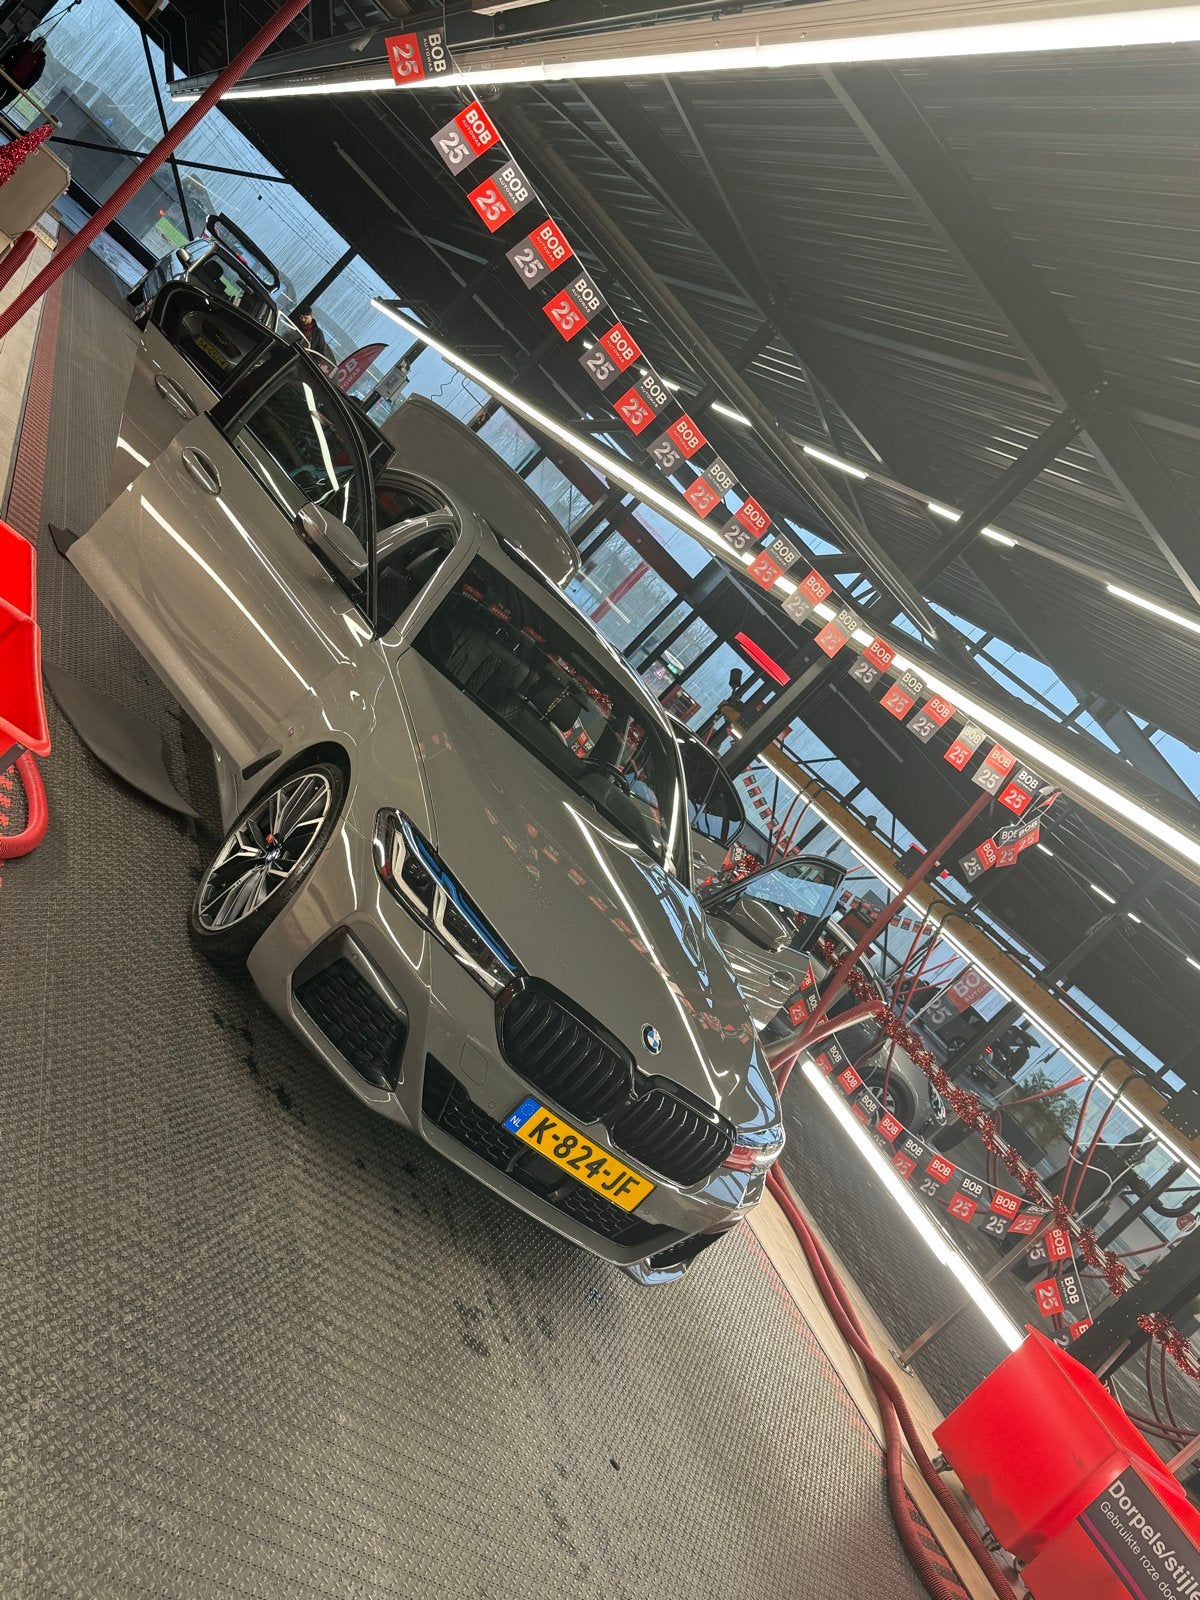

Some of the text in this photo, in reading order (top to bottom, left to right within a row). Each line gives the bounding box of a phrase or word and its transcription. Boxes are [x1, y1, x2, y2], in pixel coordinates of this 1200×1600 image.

[392, 43, 419, 77] 25
[423, 38, 434, 72] AUTOWAS
[428, 33, 447, 73] BOB
[462, 119, 482, 148] AUTOWAS
[465, 109, 492, 145] BOB
[438, 132, 470, 164] 25
[498, 177, 519, 205] AUTOWAS
[501, 167, 529, 202] BOB
[476, 189, 506, 221] 25
[536, 236, 556, 262] AUTOWAS
[539, 226, 566, 259] BOB
[514, 248, 544, 278] 25
[571, 288, 591, 314] AUTOWAS
[574, 278, 600, 311] BOB
[551, 301, 580, 330] 25
[609, 330, 634, 361] BOB
[337, 358, 358, 382] OB
[586, 352, 615, 380] 25
[340, 367, 361, 389] TOWAS
[643, 376, 667, 405] BOB
[621, 398, 648, 425] 25
[676, 421, 699, 448] BOB
[653, 442, 680, 468] 25
[710, 464, 732, 489] BOB
[690, 486, 714, 510] 25
[743, 503, 766, 528] BOB
[723, 525, 751, 549] 25
[773, 540, 795, 563] BOB
[753, 559, 777, 582] 25
[806, 576, 826, 598] BOB
[787, 596, 809, 618] 25
[838, 609, 857, 631] BOB
[820, 629, 842, 651] 25
[870, 642, 892, 664] BOB
[854, 662, 878, 684] 25
[902, 671, 923, 693] BOB
[886, 691, 909, 713] 25
[930, 698, 950, 718] BOB
[912, 716, 935, 736] 25
[963, 725, 982, 745] BOB
[949, 746, 969, 764] 25
[991, 750, 1012, 768] BOB
[977, 769, 1000, 789] 25
[1018, 770, 1039, 789] BOB
[1004, 789, 1026, 809] 25
[983, 843, 997, 863] BOB
[1018, 833, 1035, 851] 25
[963, 858, 981, 876] 25
[1000, 849, 1015, 863] 25
[953, 970, 981, 998] BO
[792, 1005, 806, 1020] 25
[829, 1045, 842, 1063] BOB
[843, 1070, 858, 1088] BOB
[861, 1094, 877, 1112] BOB
[510, 1115, 522, 1128] NL
[882, 1118, 899, 1135] BOB
[527, 1116, 641, 1197] K-824-JF
[905, 1138, 924, 1157] BOB
[894, 1157, 912, 1175] 25
[931, 1159, 951, 1176] BOB
[919, 1177, 940, 1197] 25
[962, 1177, 983, 1195] BOB
[952, 1199, 973, 1217] 25
[995, 1194, 1017, 1211] BOB
[985, 1215, 1008, 1234] 25
[1013, 1216, 1037, 1231] 25
[1052, 1229, 1067, 1256] BOB
[1038, 1286, 1059, 1310] 25
[1064, 1276, 1080, 1305] BOB
[1100, 1501, 1141, 1555] Gebruikte
[1139, 1554, 1160, 1581] roze
